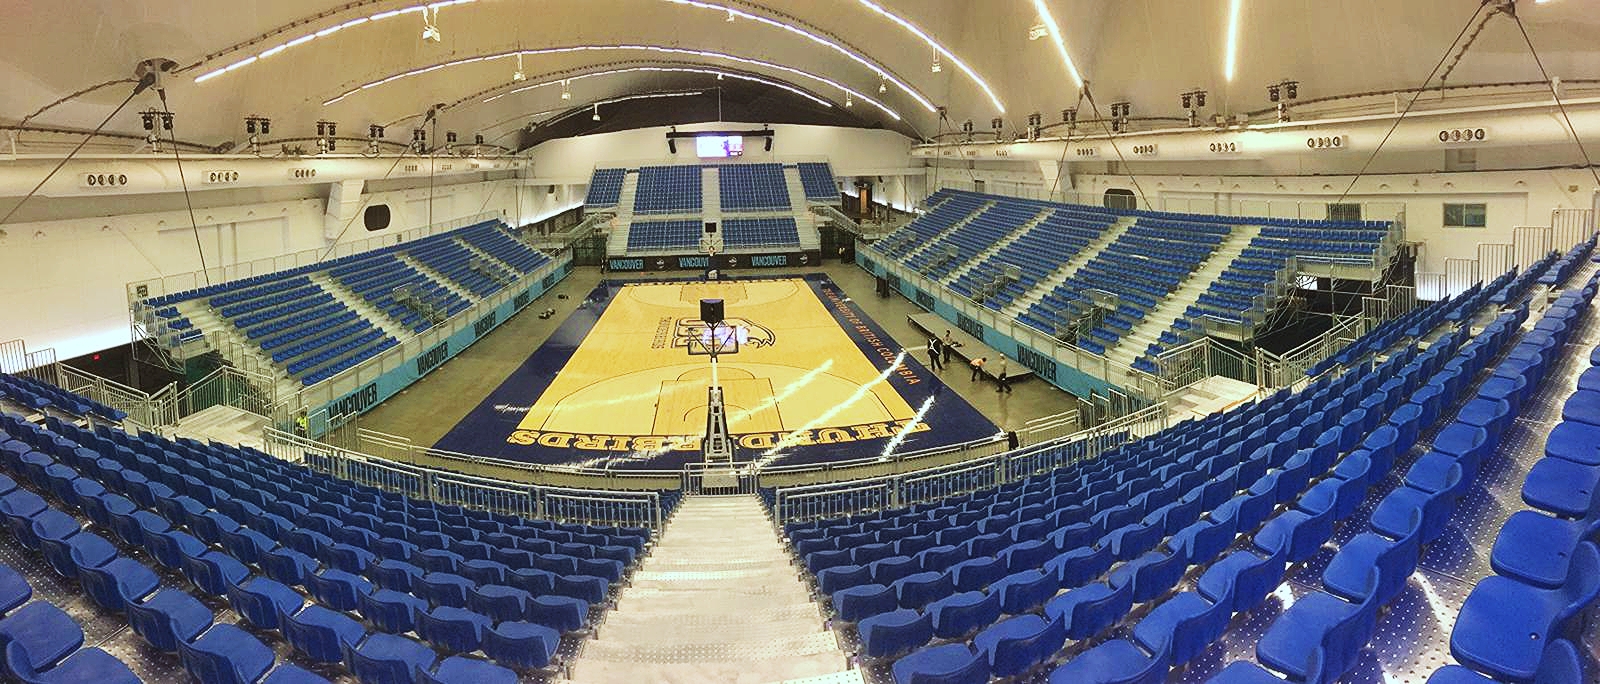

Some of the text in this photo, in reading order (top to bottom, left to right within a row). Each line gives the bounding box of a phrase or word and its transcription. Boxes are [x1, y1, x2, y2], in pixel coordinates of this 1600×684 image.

[610, 259, 643, 270] VANCOUVER
[679, 257, 709, 268] VANCOUV
[752, 255, 786, 267] VANCOUVER
[417, 341, 448, 376] VANCOUVER
[1017, 343, 1057, 382] VANCOUVER
[328, 382, 378, 426] VANCOUVER
